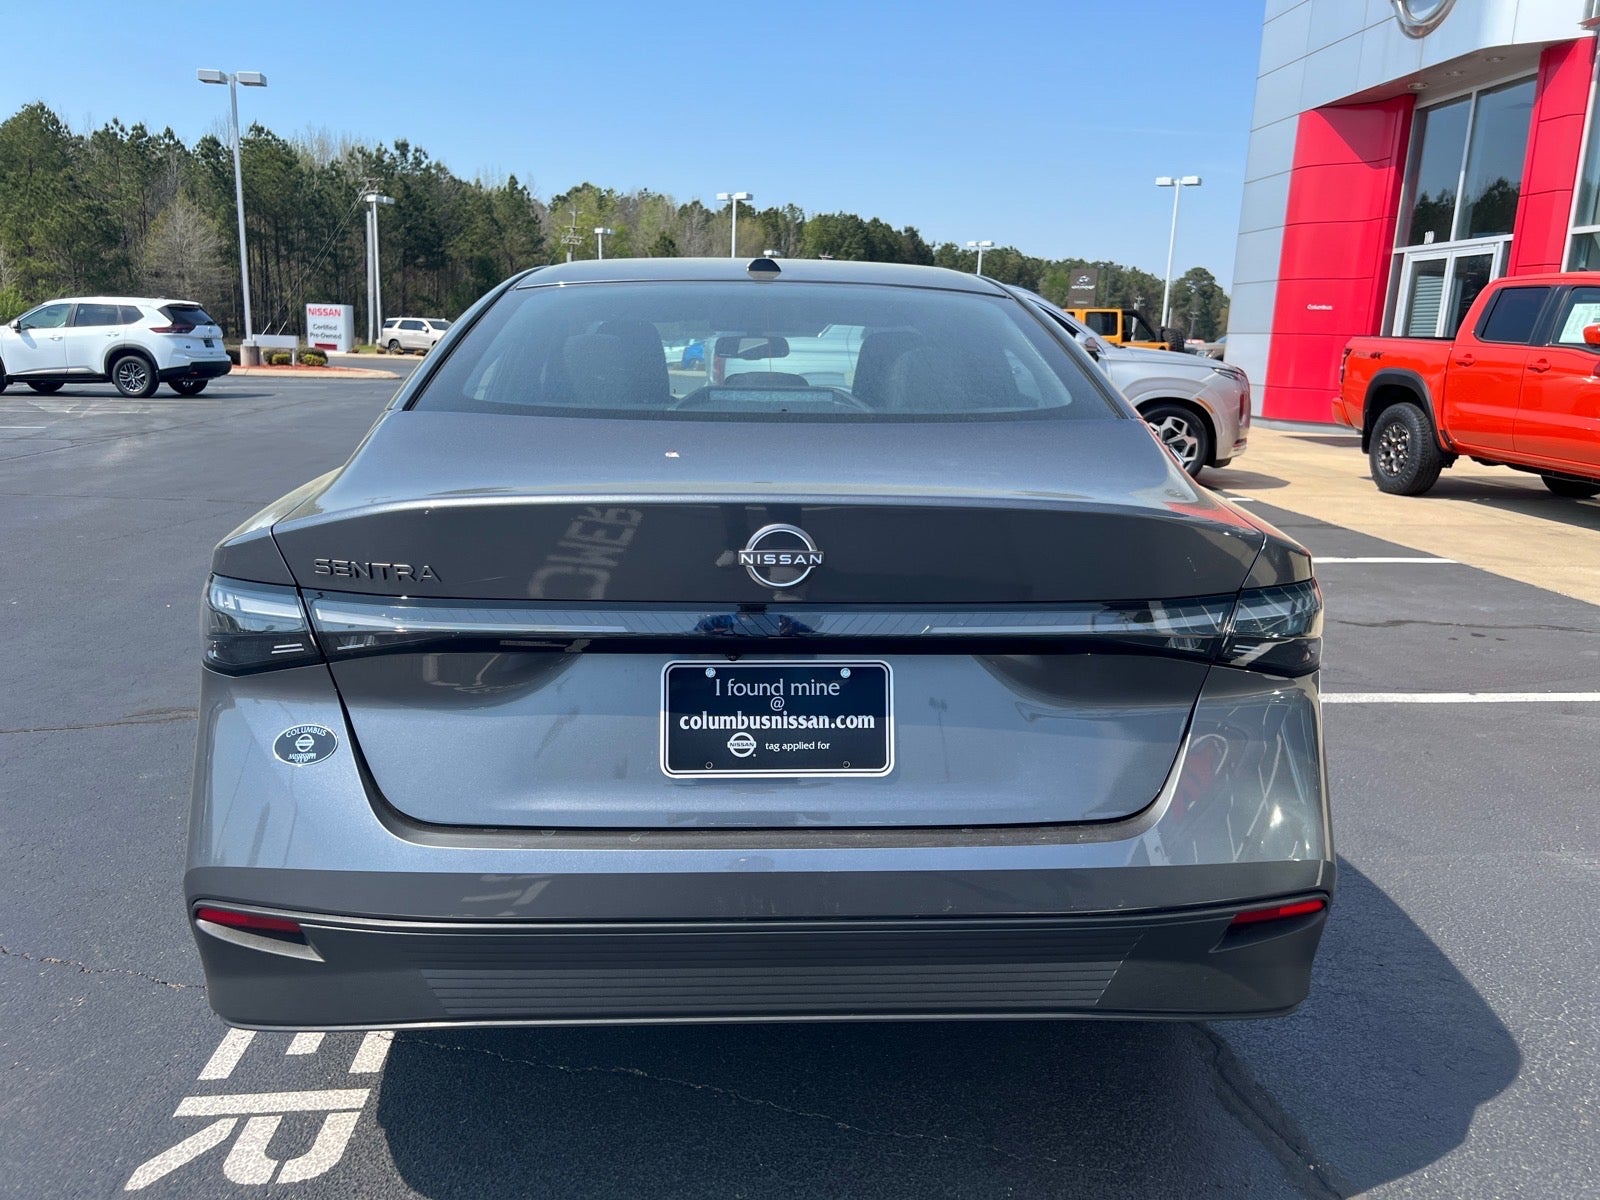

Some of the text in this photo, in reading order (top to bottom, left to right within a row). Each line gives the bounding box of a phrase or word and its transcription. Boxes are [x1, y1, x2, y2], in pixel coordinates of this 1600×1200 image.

[308, 307, 341, 317] NISSAN
[309, 332, 342, 340] Pre-Owned
[740, 553, 823, 565] NISSAN
[313, 558, 443, 583] SENTRA
[715, 678, 841, 697] I found mine
[769, 696, 785, 712] @
[679, 710, 875, 730] columbusnissan.com
[285, 726, 327, 738] COLUMBUS
[765, 741, 831, 752] tag applied for
